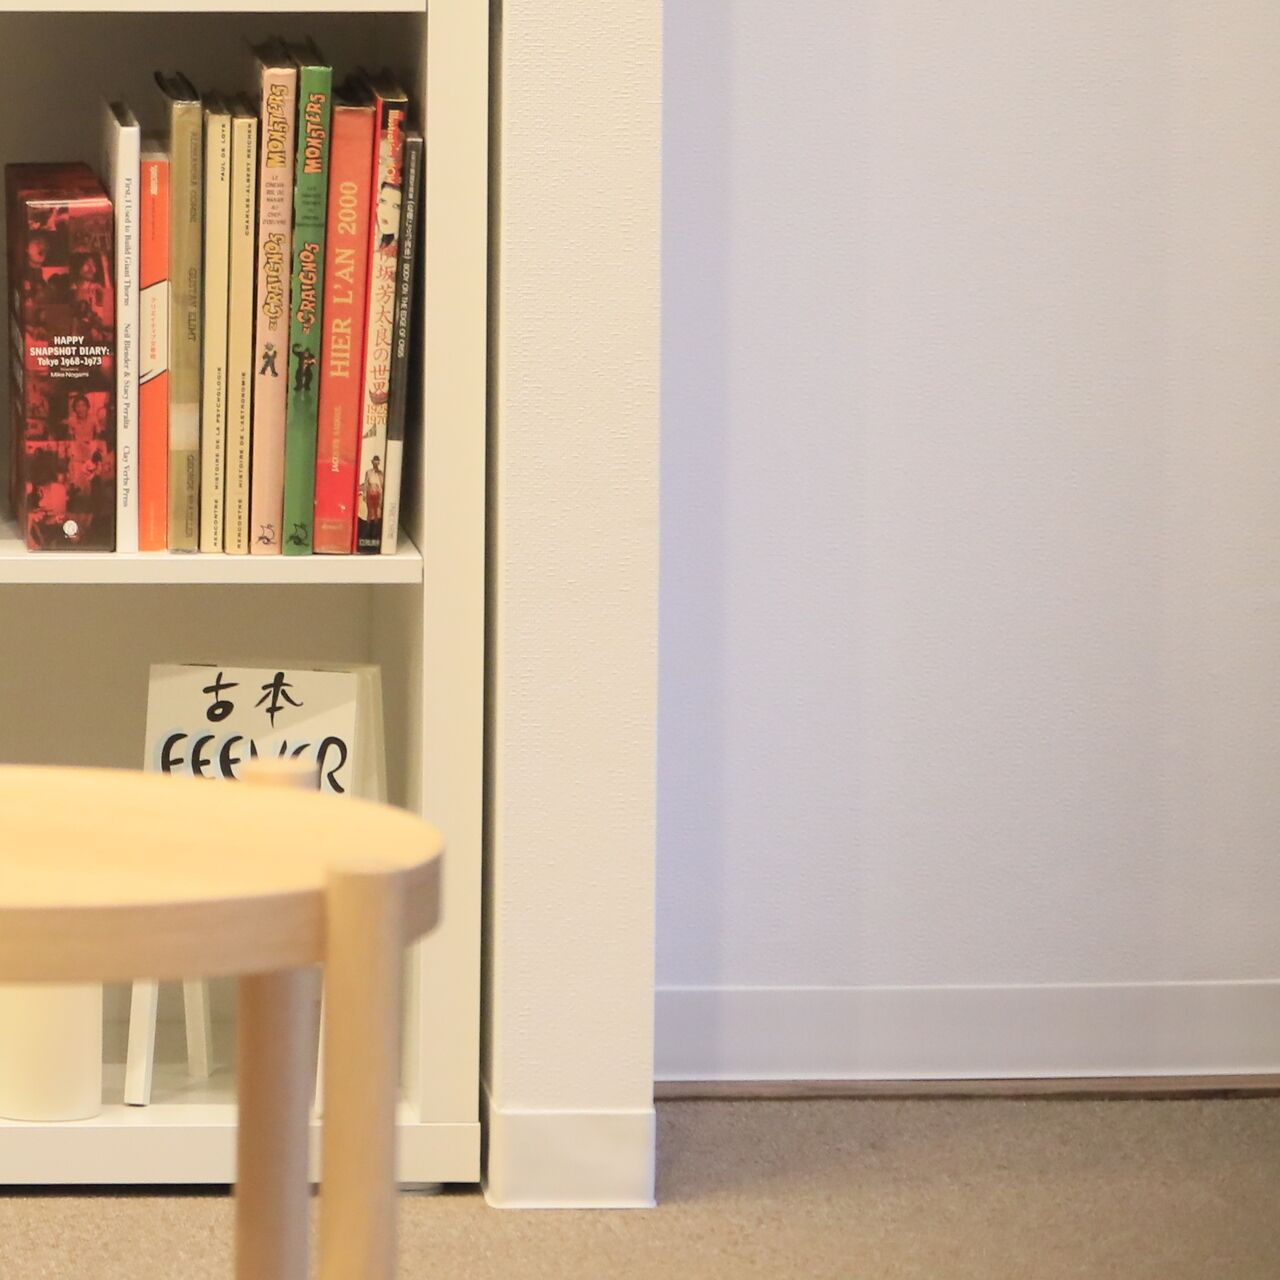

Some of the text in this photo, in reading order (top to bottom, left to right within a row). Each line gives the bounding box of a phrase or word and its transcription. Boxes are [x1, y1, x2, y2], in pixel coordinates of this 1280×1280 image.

[264, 84, 289, 169] MONSTERS
[303, 92, 326, 174] MONSTERS
[122, 177, 133, 199] First,
[123, 205, 132, 223] Used
[123, 223, 132, 233] to
[123, 234, 133, 255] Build
[122, 256, 133, 278] Giant
[329, 181, 359, 380] HIER L'AN 2000
[123, 279, 133, 307] Thorns
[29, 346, 110, 356] SNAPSHOT DIARY:
[53, 336, 85, 345] HAPPY
[37, 357, 102, 367] Tokyo 1968-1973
[120, 445, 131, 508] Clay Verbs Press
[202, 671, 304, 728] 古本
